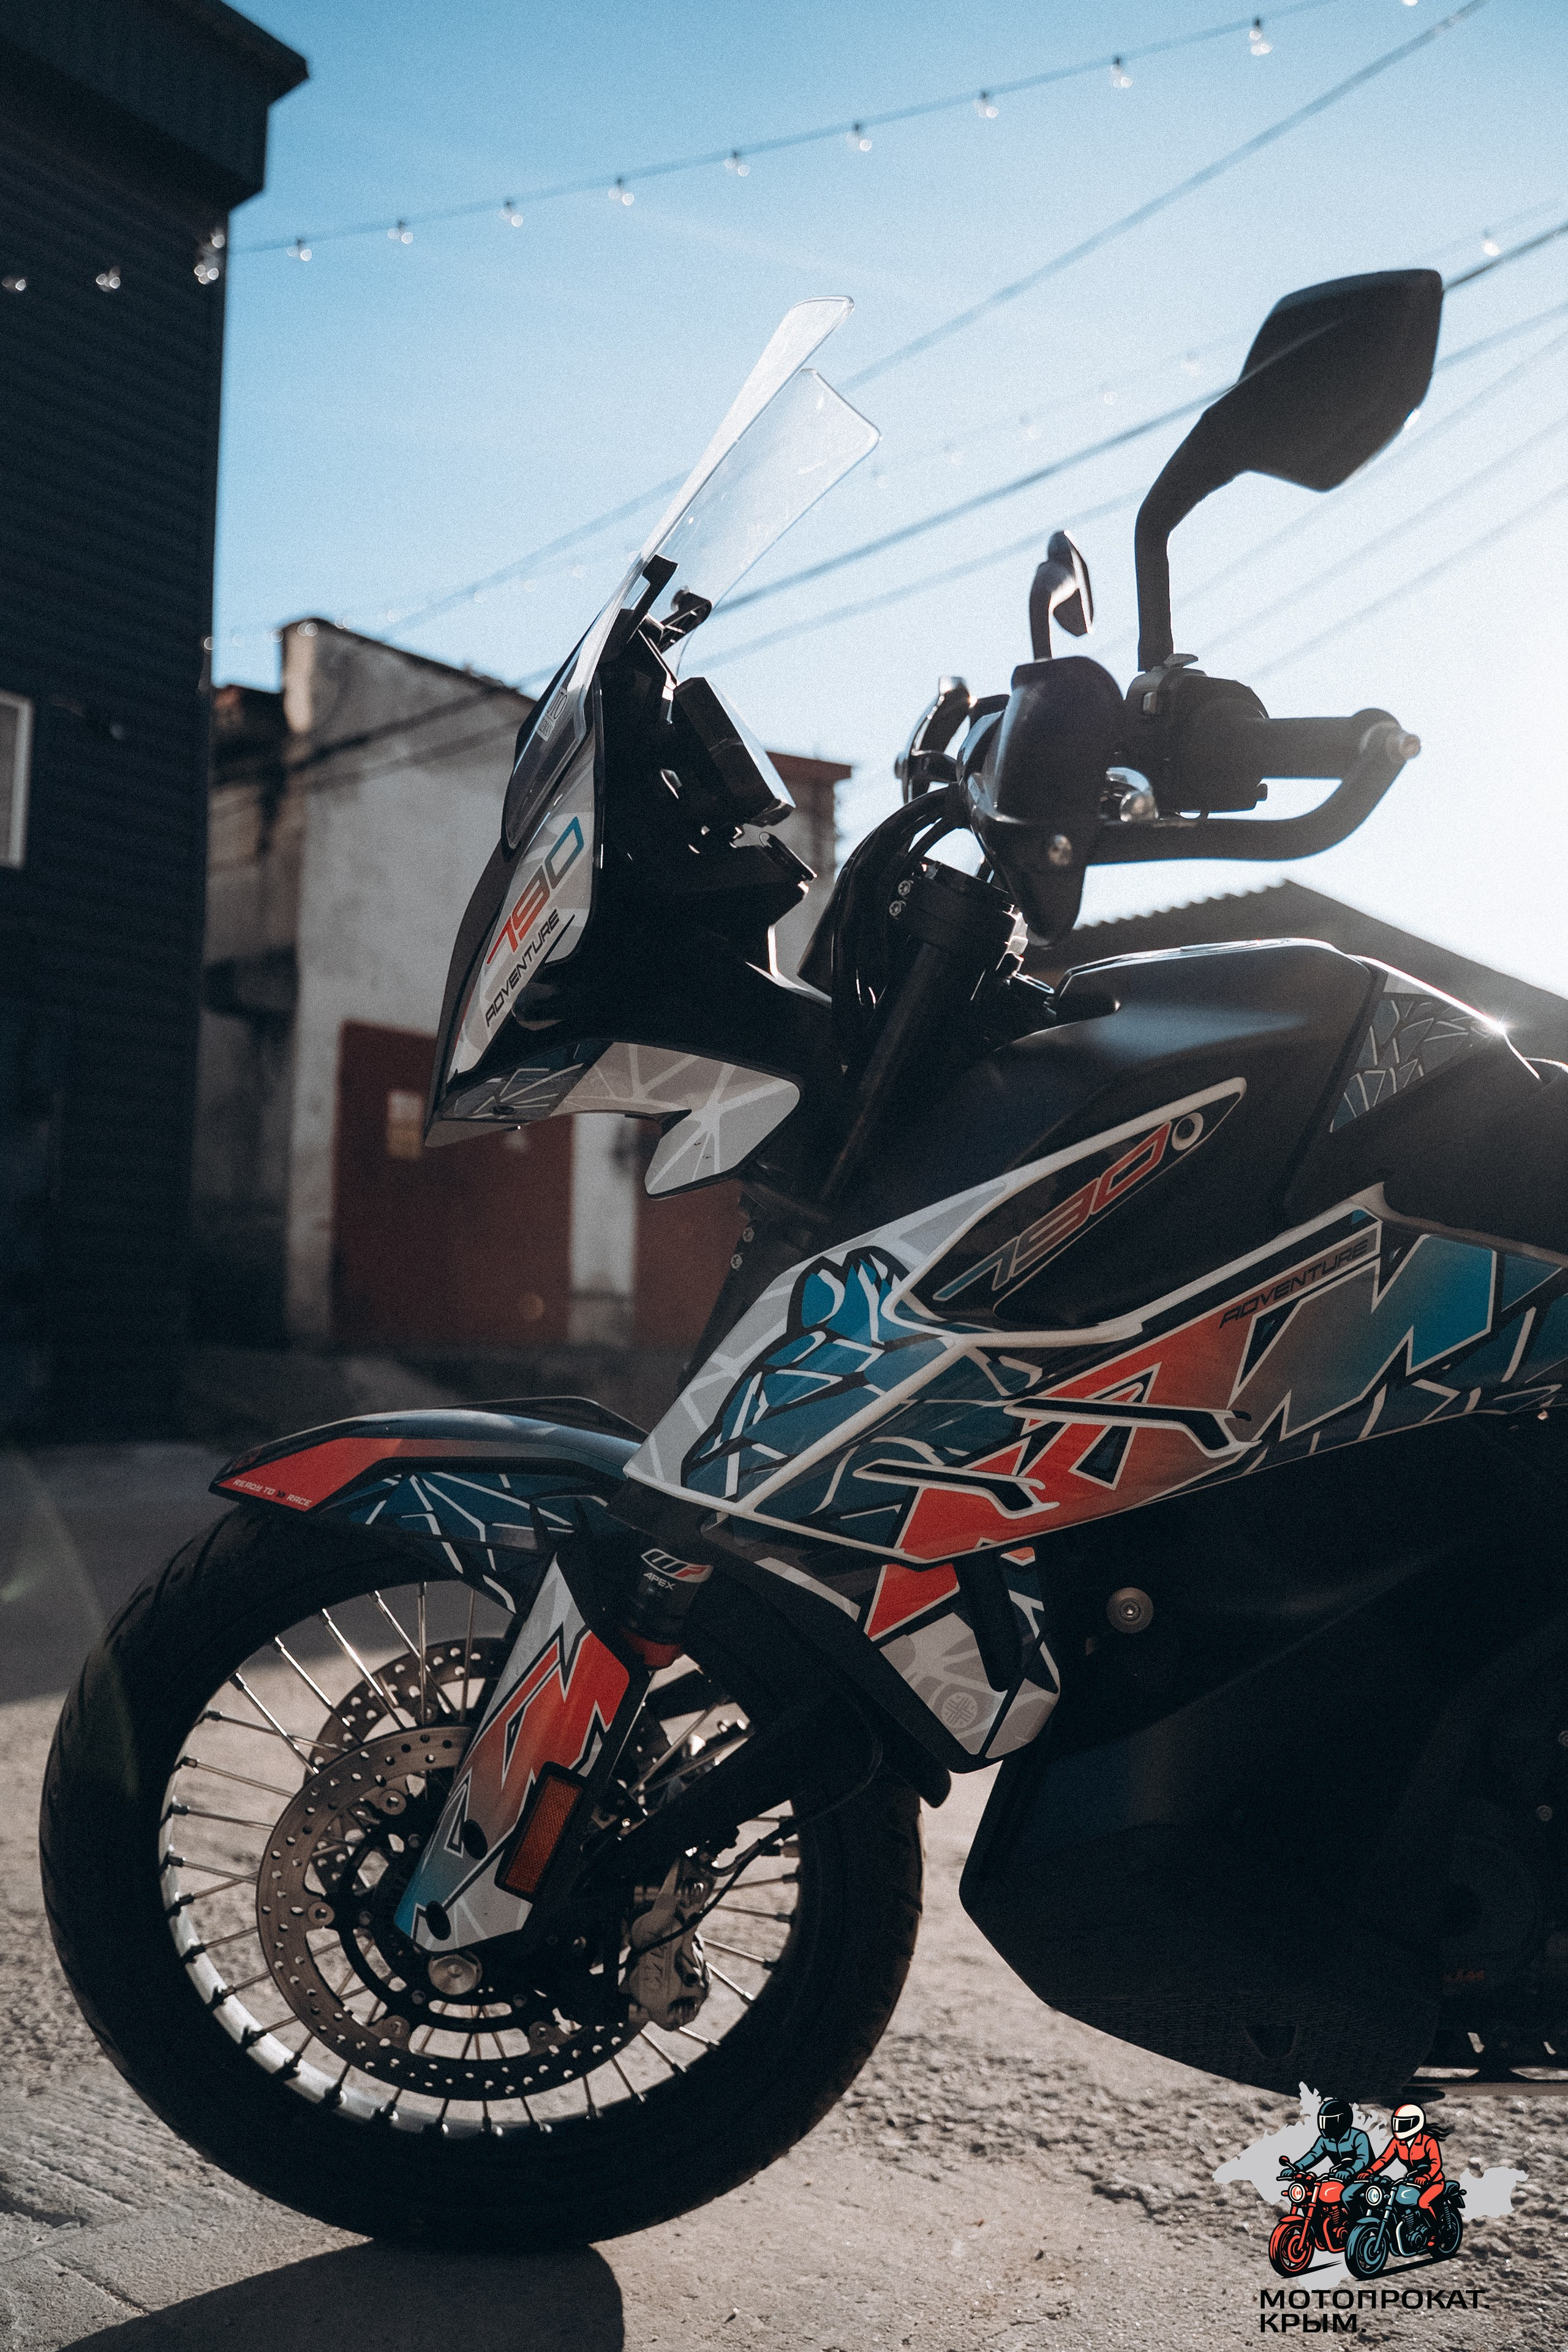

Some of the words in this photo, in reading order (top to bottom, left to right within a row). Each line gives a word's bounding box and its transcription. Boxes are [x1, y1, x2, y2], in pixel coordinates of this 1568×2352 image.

[486, 816, 584, 965] 790
[484, 908, 560, 1028] ADVENTURE
[932, 1120, 1172, 1302] 790
[1218, 1238, 1369, 1330] ADVENTURE
[233, 1479, 263, 1491] READY
[264, 1487, 276, 1495] TO
[287, 1494, 312, 1506] RACE
[643, 1572, 676, 1591] APEX
